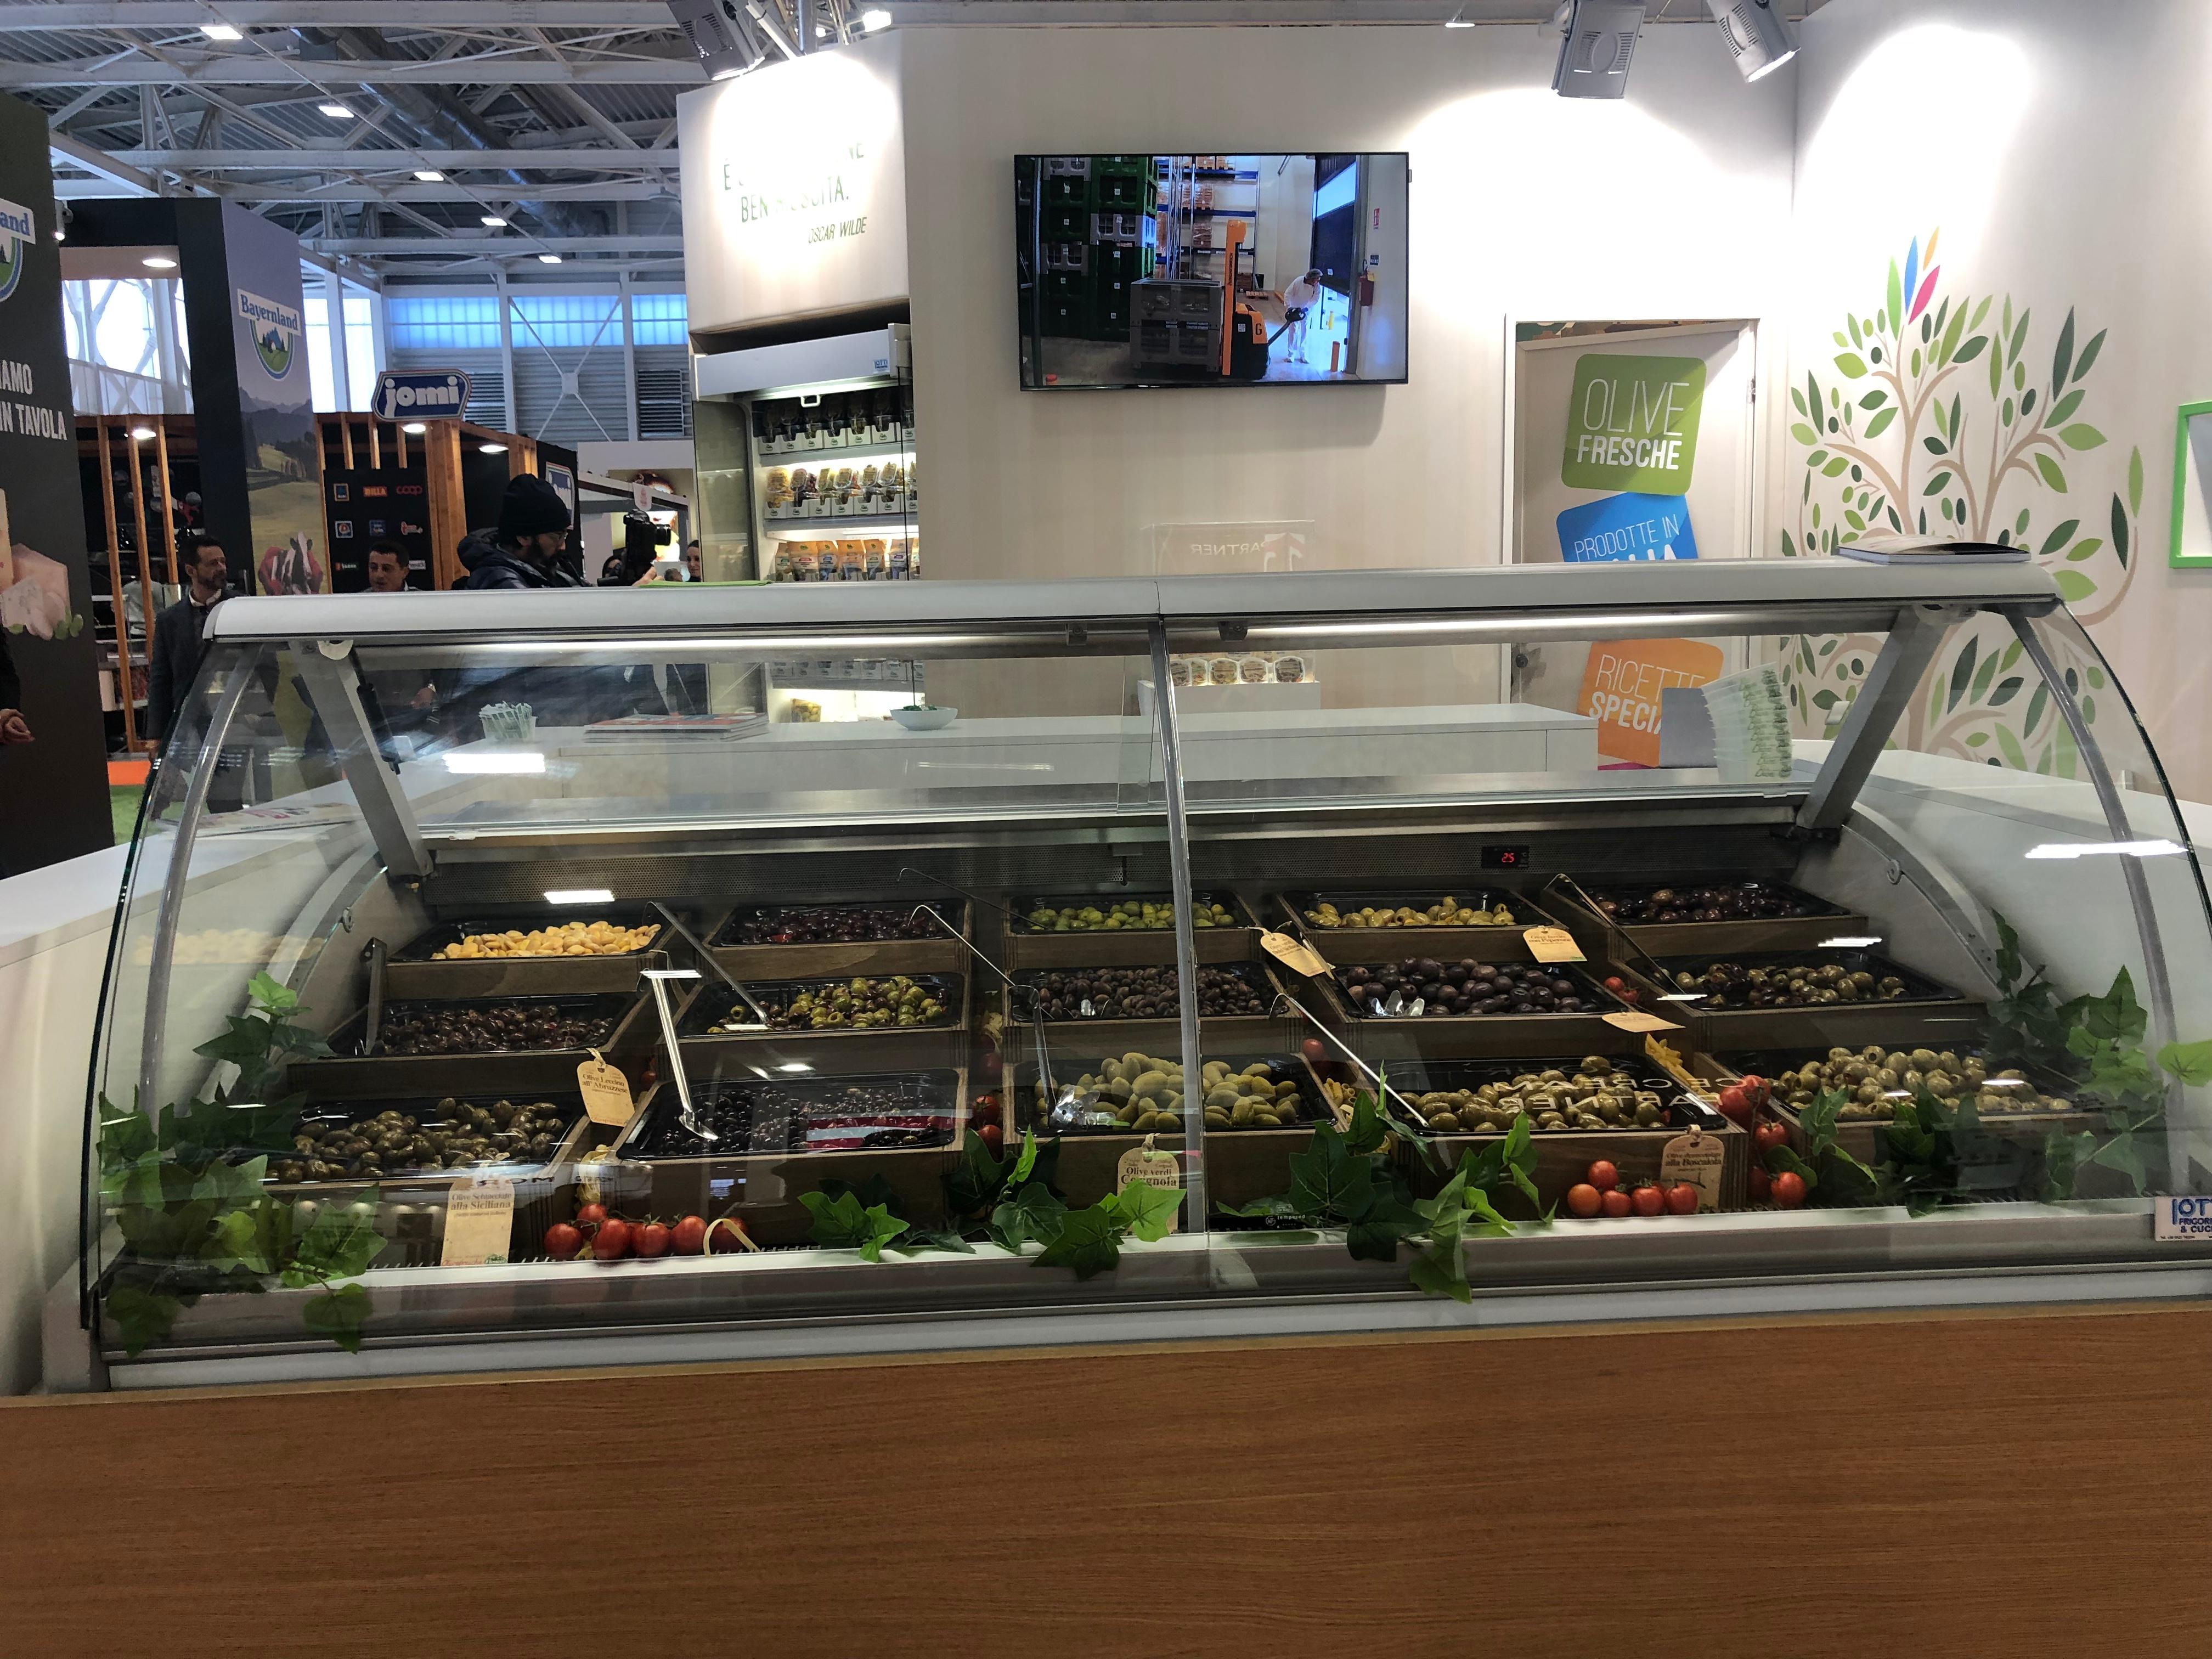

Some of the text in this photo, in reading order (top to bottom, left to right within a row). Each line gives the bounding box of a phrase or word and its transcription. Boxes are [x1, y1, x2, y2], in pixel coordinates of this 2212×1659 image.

[808, 217, 867, 244] OSCAR WILDE
[240, 294, 298, 331] Bayernland
[1255, 323, 1262, 336] G
[0, 359, 33, 395] AMO
[384, 376, 460, 419] jomi
[1583, 379, 1690, 436] OLIVE
[15, 403, 67, 441] TAVOLA
[1577, 435, 1683, 470] FRESCHE
[1574, 514, 1680, 562] PRODOTTE IN
[1126, 1167, 1149, 1176] Olive
[451, 1200, 511, 1210] alla Siciliana
[2172, 1199, 2212, 1226] IOT
